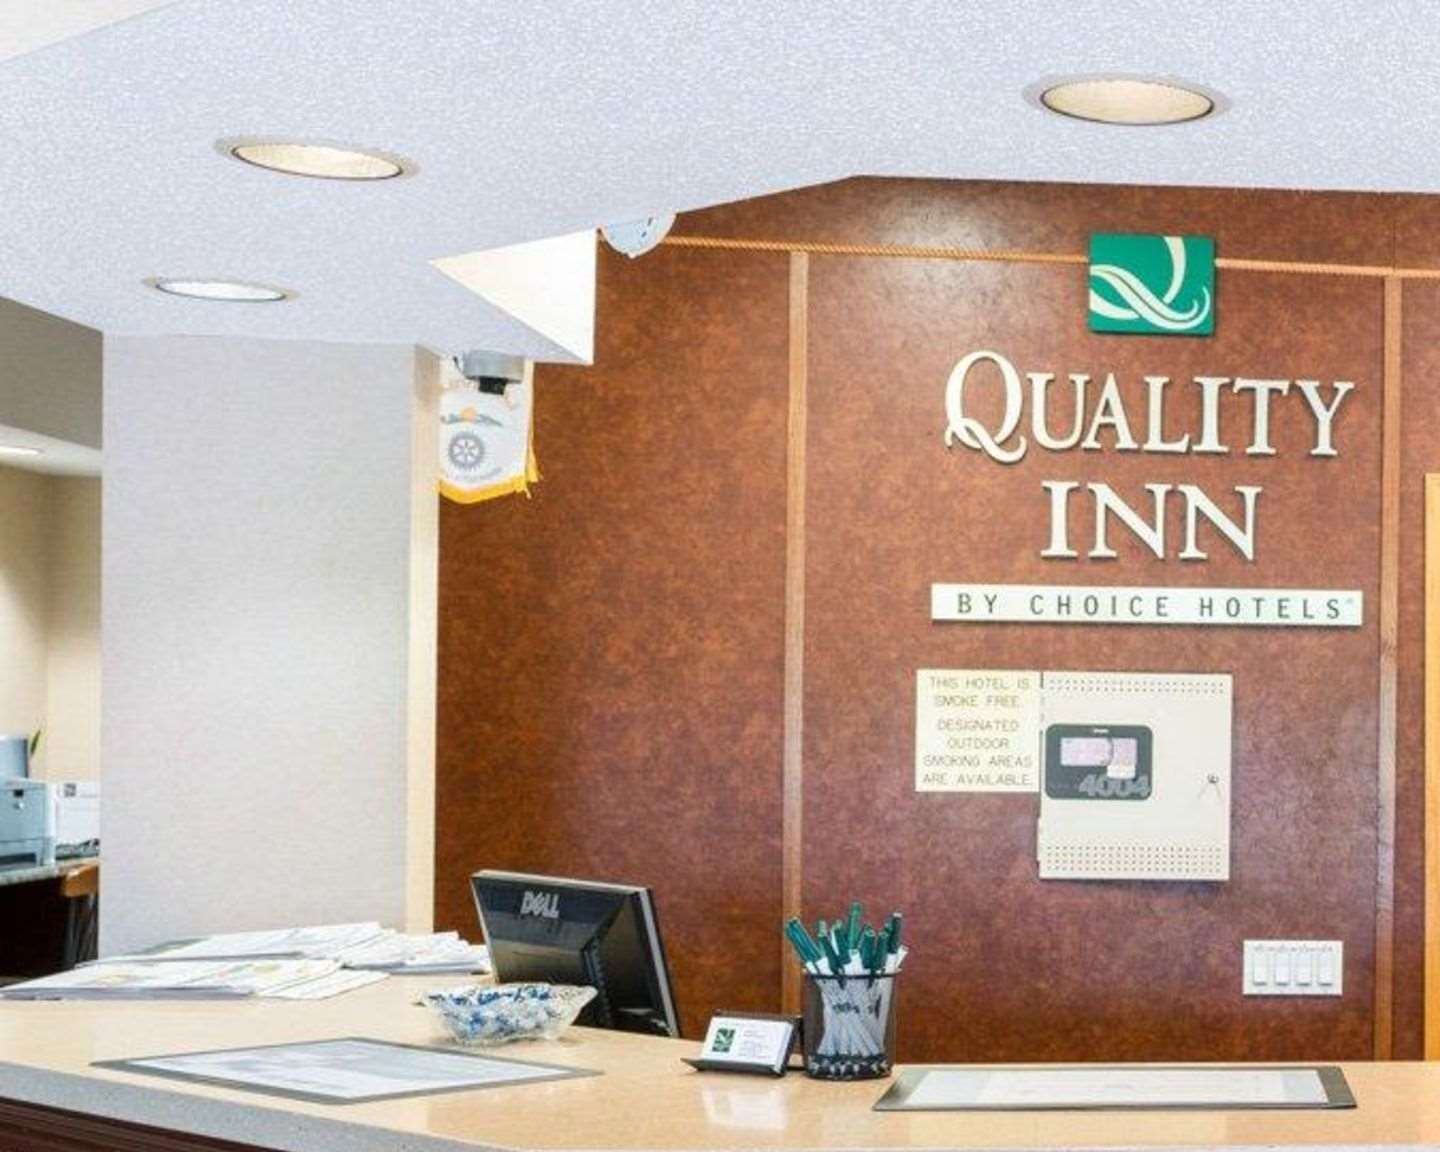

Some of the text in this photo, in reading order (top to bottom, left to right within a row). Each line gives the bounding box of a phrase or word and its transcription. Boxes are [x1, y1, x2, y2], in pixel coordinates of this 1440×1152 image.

[945, 350, 1355, 463] QUALITY
[1040, 480, 1263, 560] INN
[957, 593, 999, 614] BY
[1030, 594, 1170, 617] CHOICE
[930, 676, 1030, 690] THIS HOTEL IS
[935, 694, 977, 707] SMOKE
[938, 718, 1020, 732] DESIGNATED
[947, 736, 1010, 750] OUTDOOR
[923, 754, 1032, 768] SMOKING AREAS
[923, 772, 949, 785] ARE
[520, 891, 560, 919] DELL
